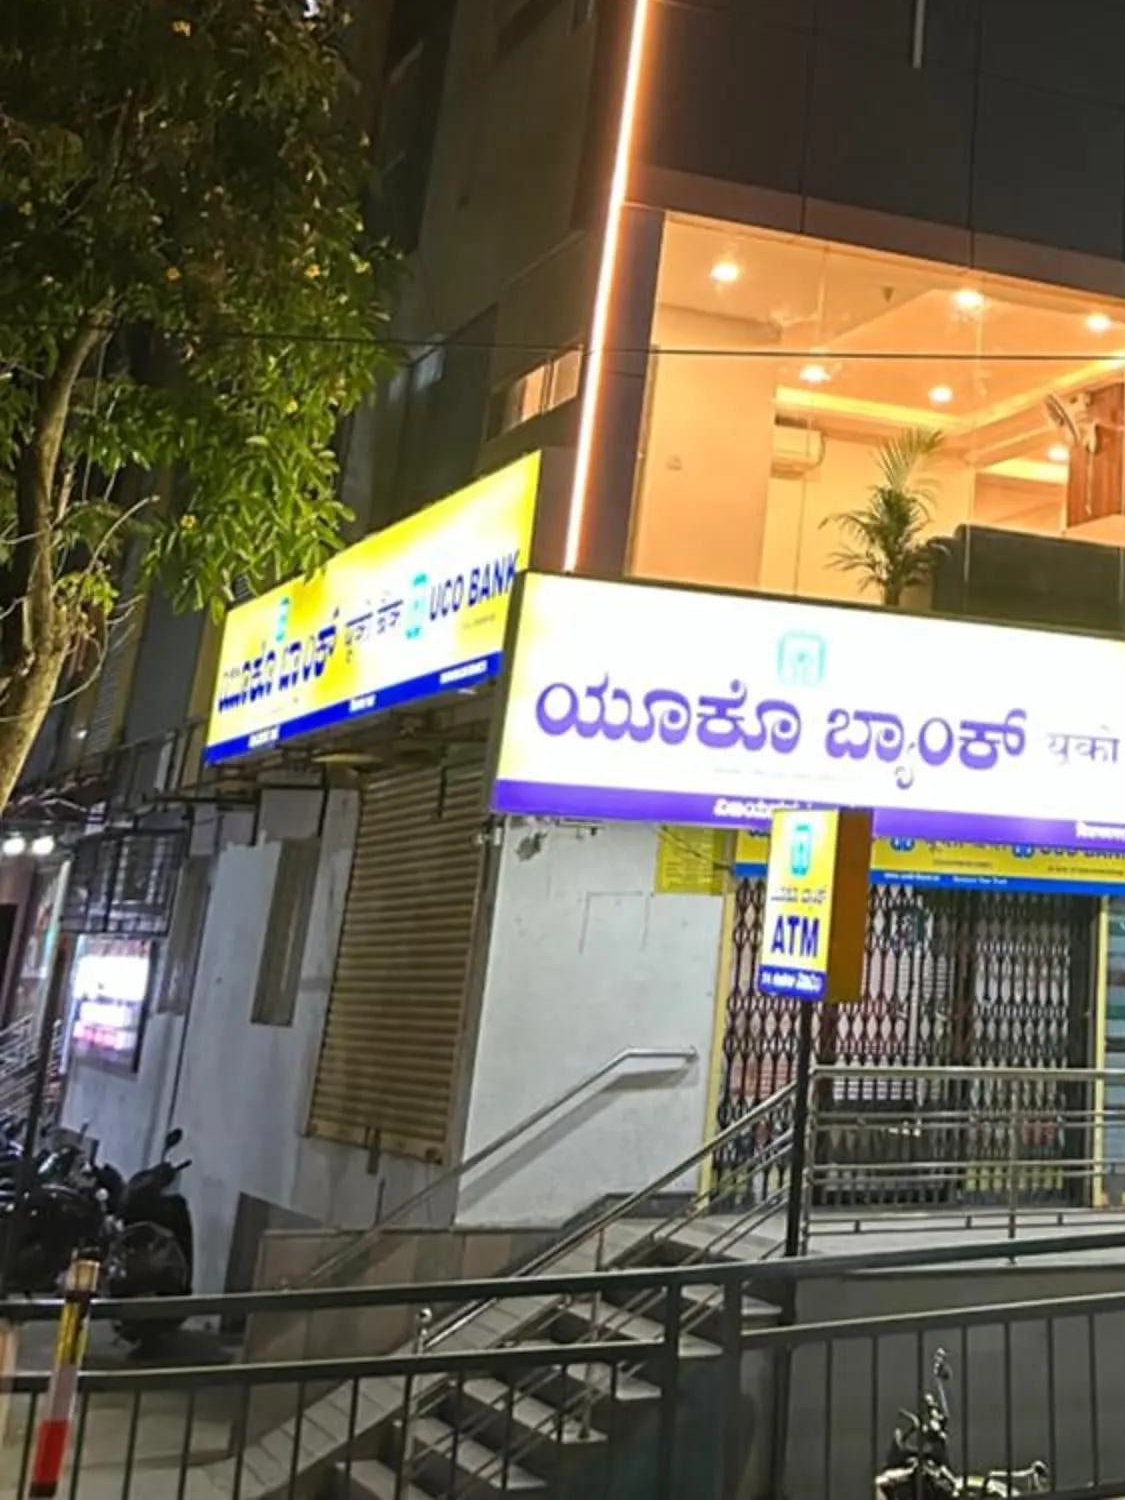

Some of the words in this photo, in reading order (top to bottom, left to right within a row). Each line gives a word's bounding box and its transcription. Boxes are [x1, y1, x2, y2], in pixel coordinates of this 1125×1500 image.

[429, 574, 465, 621] UCO
[467, 549, 520, 607] BANK
[824, 708, 1027, 790] ಬ್ಯಾಂಕ್
[769, 915, 820, 959] ATM
